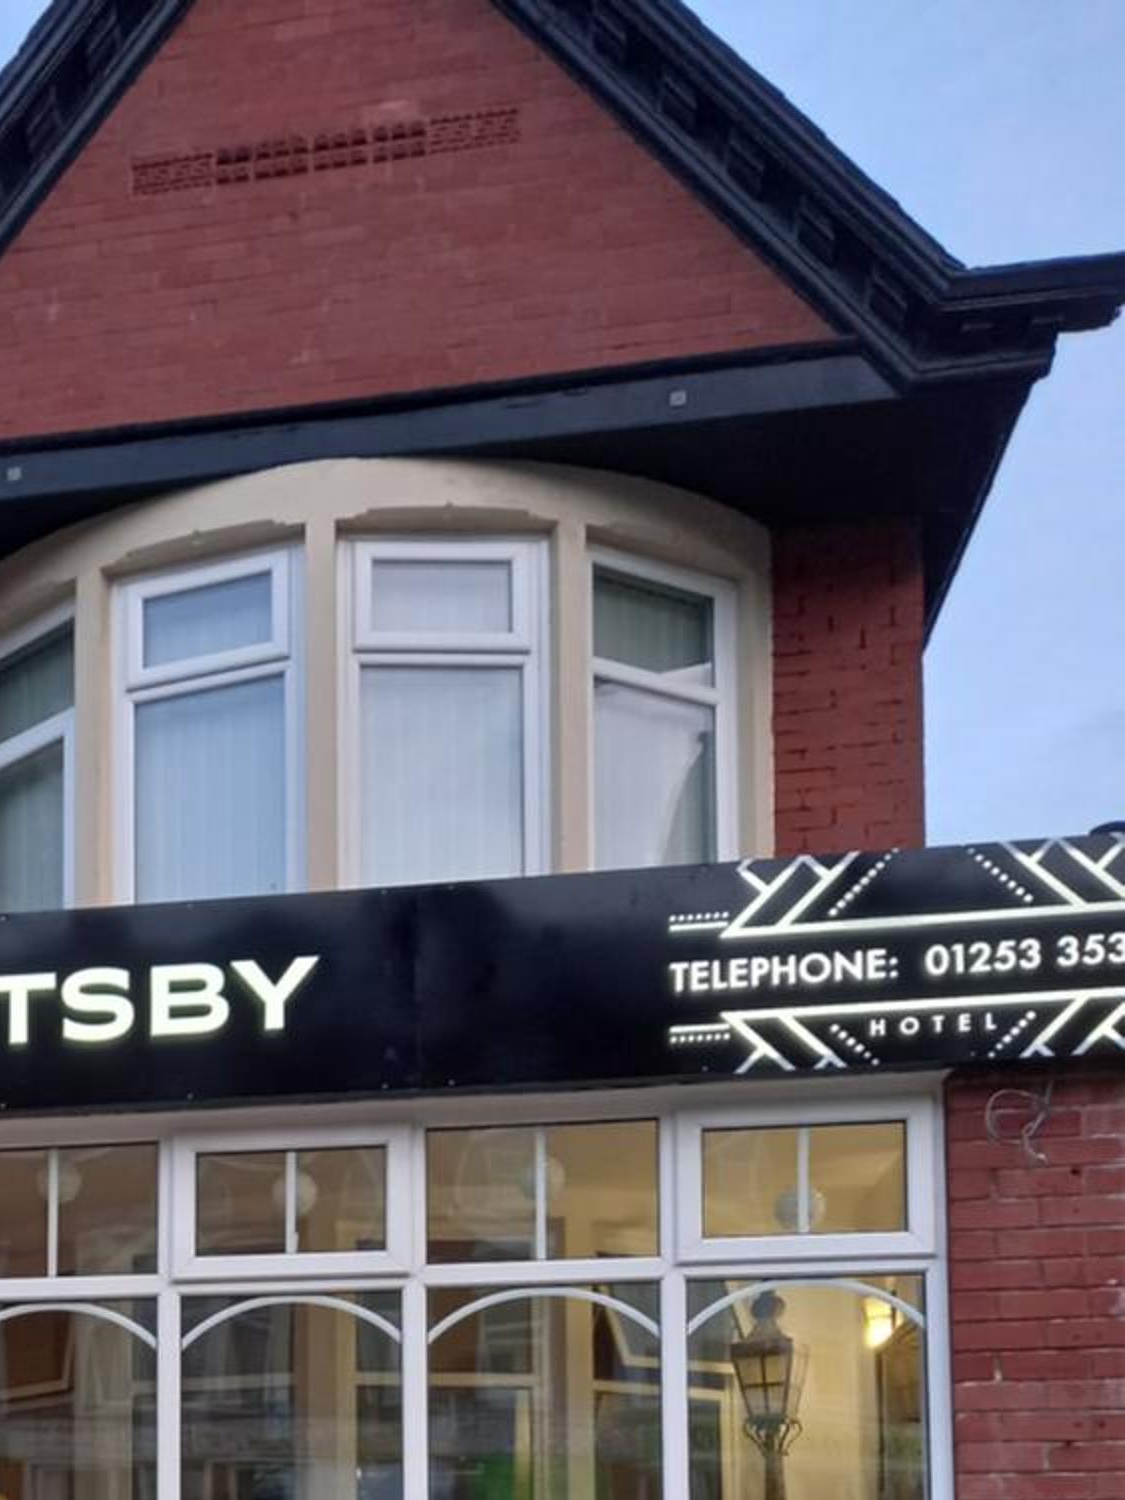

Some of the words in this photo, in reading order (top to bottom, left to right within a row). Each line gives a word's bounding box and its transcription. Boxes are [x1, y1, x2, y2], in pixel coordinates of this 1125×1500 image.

[668, 948, 899, 993] TELEPHONE:
[924, 937, 1042, 977] 01253
[1056, 931, 1125, 968] 353
[869, 1011, 997, 1037] HOTEL
